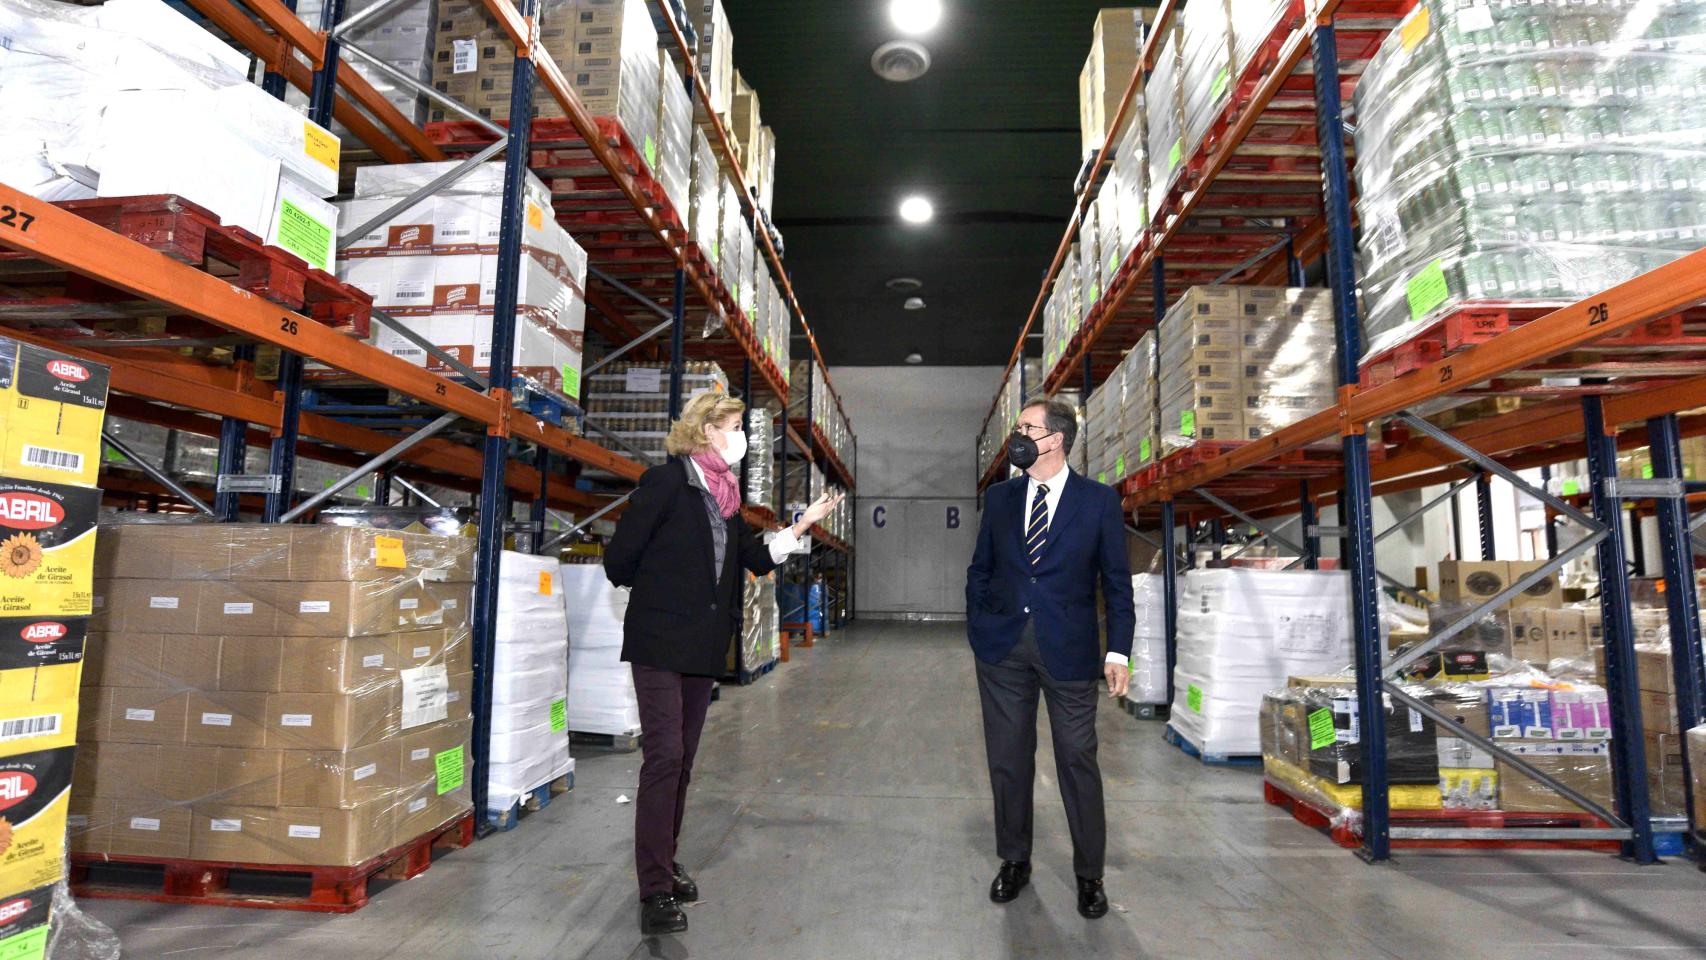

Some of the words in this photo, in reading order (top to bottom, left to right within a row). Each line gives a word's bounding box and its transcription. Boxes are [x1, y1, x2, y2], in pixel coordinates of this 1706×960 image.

[0, 205, 35, 232] 27
[1588, 302, 1608, 326] 26
[281, 316, 298, 336] 26
[51, 361, 86, 380] ABRIL
[1440, 365, 1453, 382] 25
[53, 384, 61, 392] de
[61, 386, 81, 396] Girasol
[59, 381, 76, 389] Aceite
[435, 382, 447, 396] 25
[0, 497, 57, 523] ABRIL
[873, 505, 887, 528] C
[946, 506, 960, 529] B
[3, 604, 32, 612] Girasol
[25, 624, 63, 639] ABRIL
